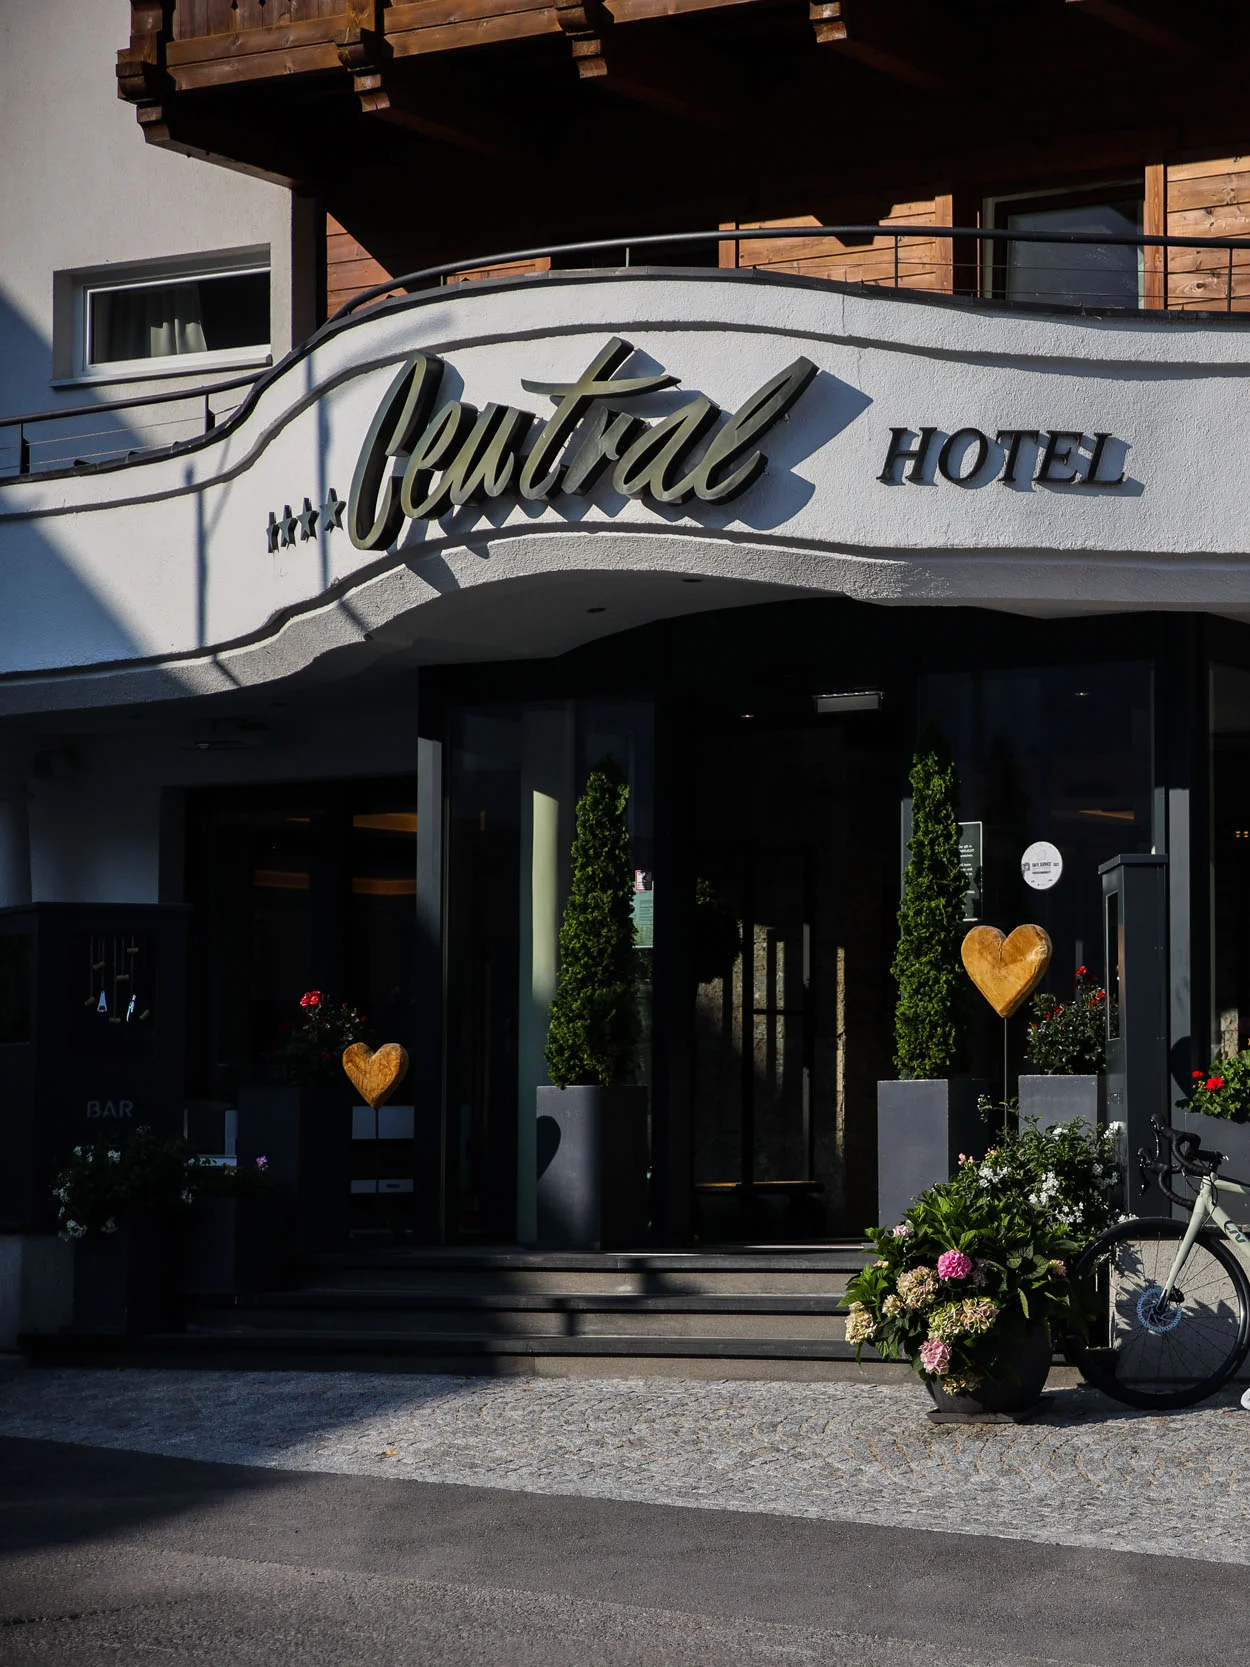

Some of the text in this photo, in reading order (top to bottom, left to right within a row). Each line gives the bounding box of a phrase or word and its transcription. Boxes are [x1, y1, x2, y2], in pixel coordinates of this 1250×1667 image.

[348, 336, 1126, 551] Central HOTEL
[86, 1099, 133, 1119] BAR
